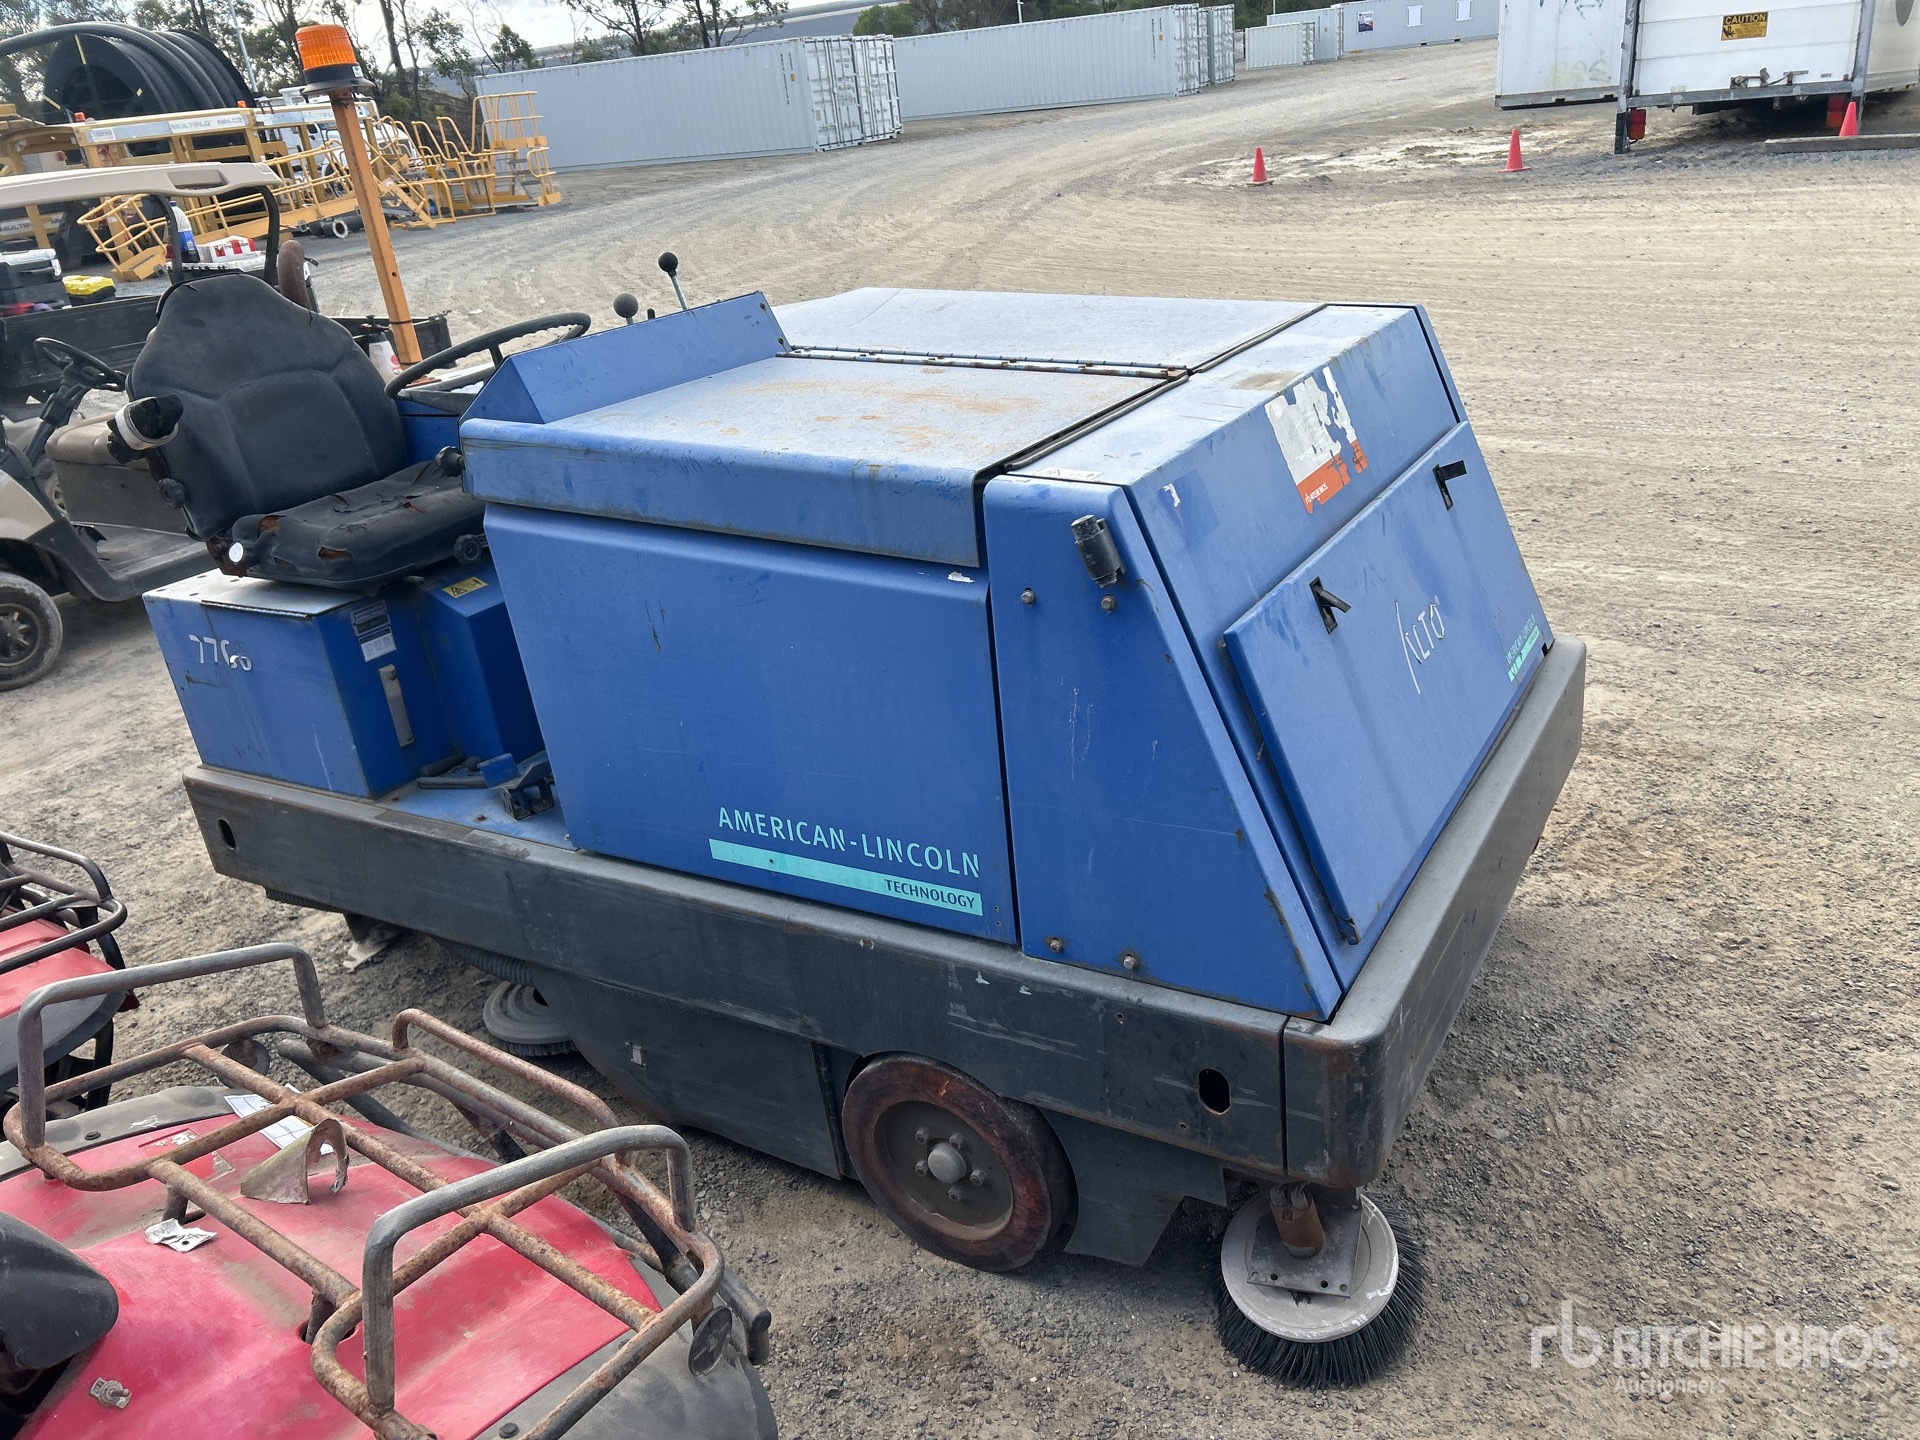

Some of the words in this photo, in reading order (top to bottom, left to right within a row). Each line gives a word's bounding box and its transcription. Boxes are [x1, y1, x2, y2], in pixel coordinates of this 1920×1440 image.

[1725, 13, 1766, 25] CAUTION
[719, 806, 979, 878] AMERICAN-LINCOLN
[884, 878, 975, 909] TECHNOLOGY
